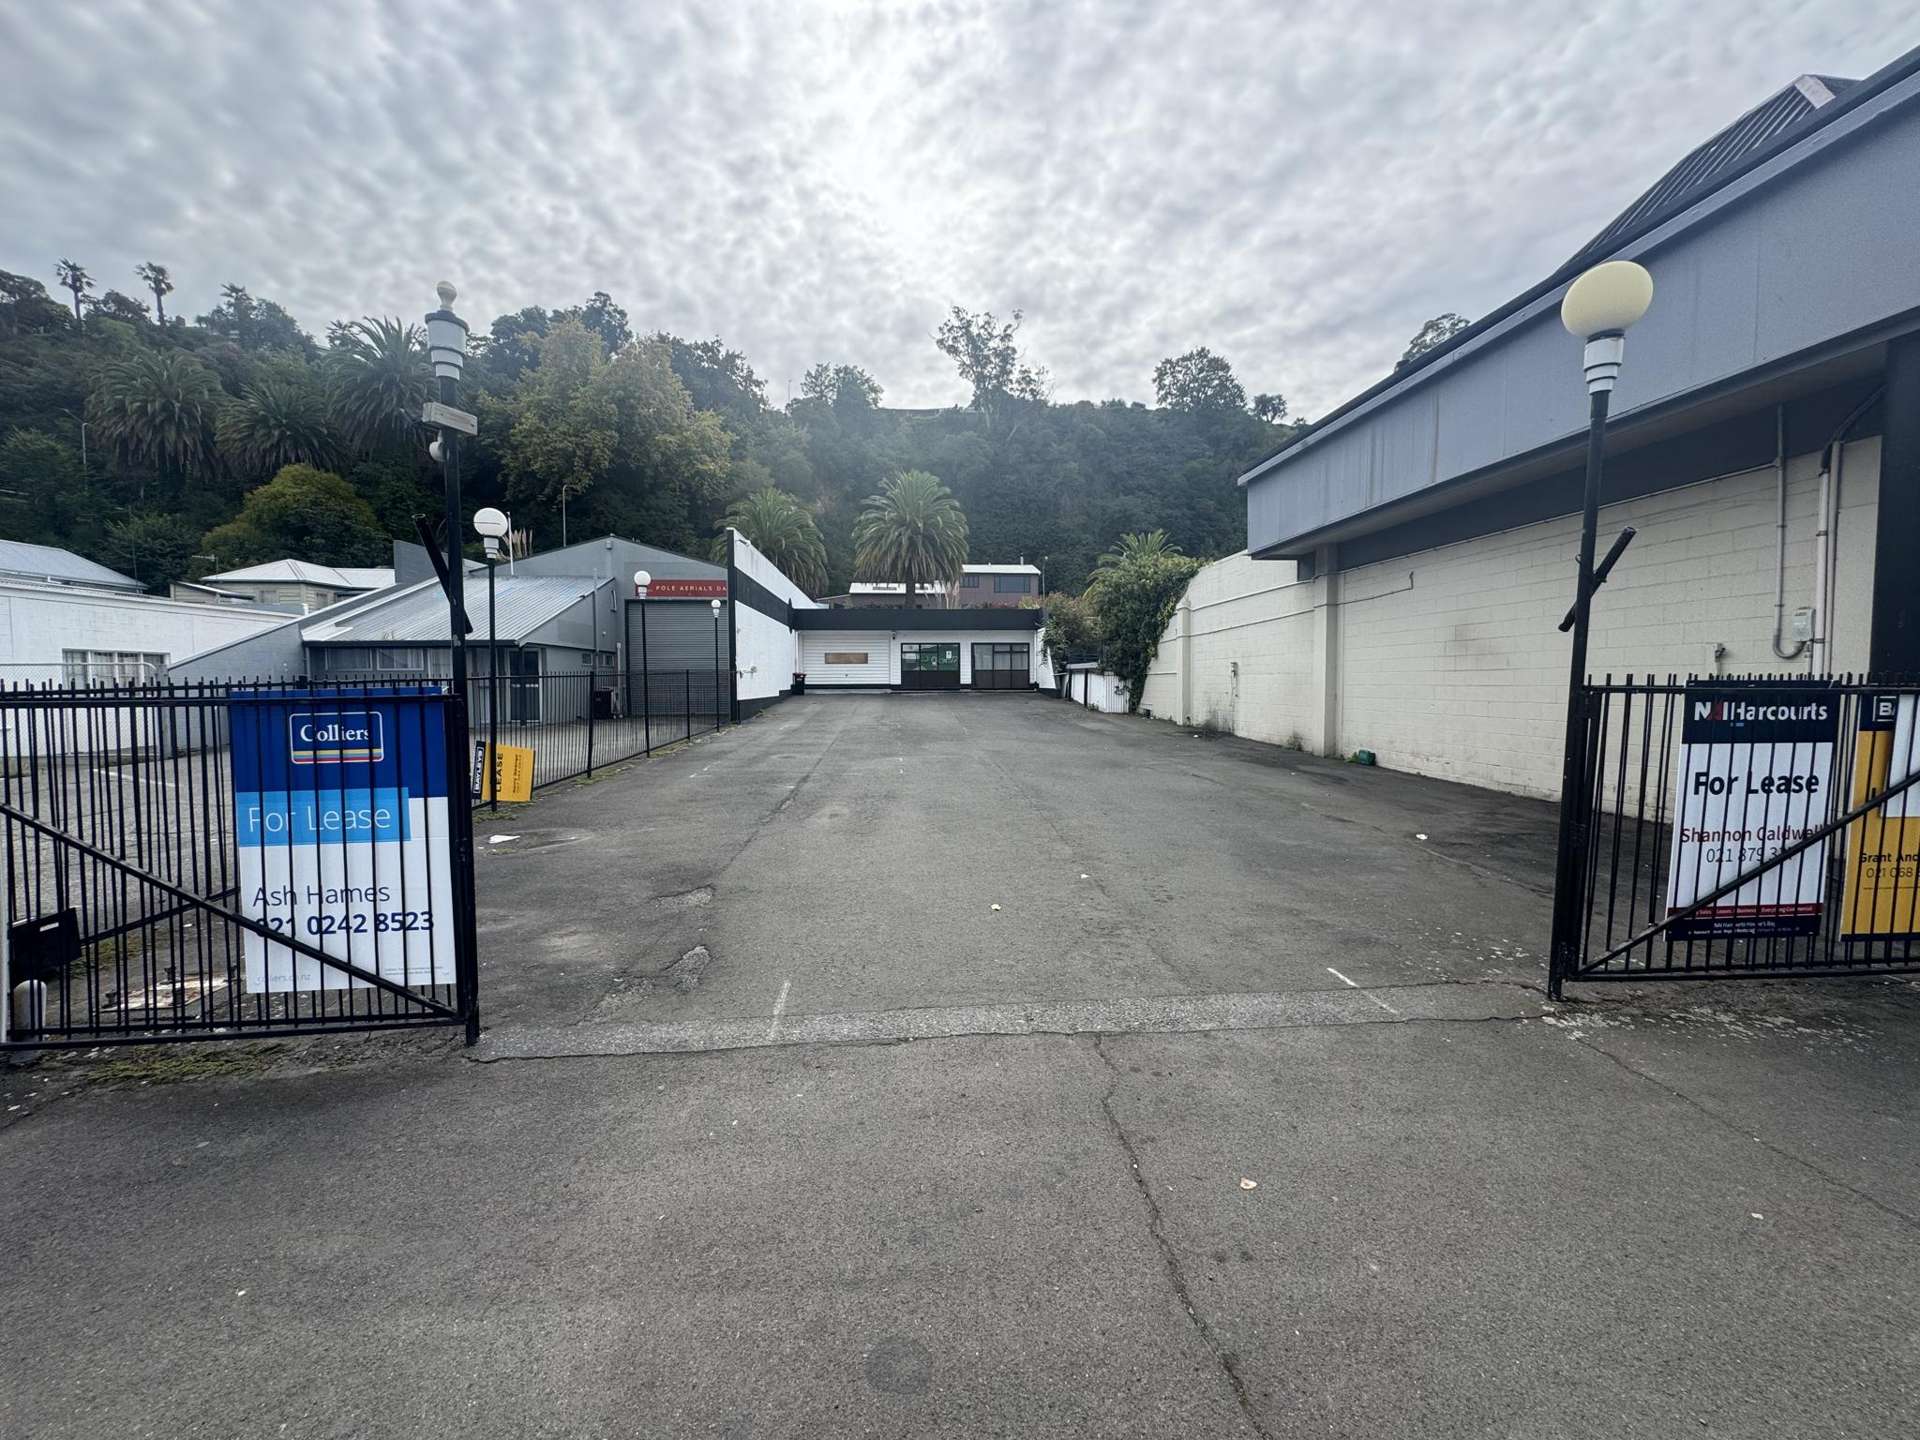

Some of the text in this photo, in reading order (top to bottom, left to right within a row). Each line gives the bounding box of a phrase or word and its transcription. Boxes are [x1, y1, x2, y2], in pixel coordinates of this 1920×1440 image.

[1730, 701, 1828, 721] Harcourts
[300, 723, 369, 742] Colliers
[1693, 770, 1820, 796] For Lease
[249, 805, 391, 833] For Lease
[1680, 827, 1752, 843] Shannon
[1860, 852, 1892, 863] Grant
[1866, 867, 1886, 879] 01
[252, 885, 391, 907] Ash Hames
[307, 913, 368, 935] 0242
[375, 911, 434, 933] 8523
